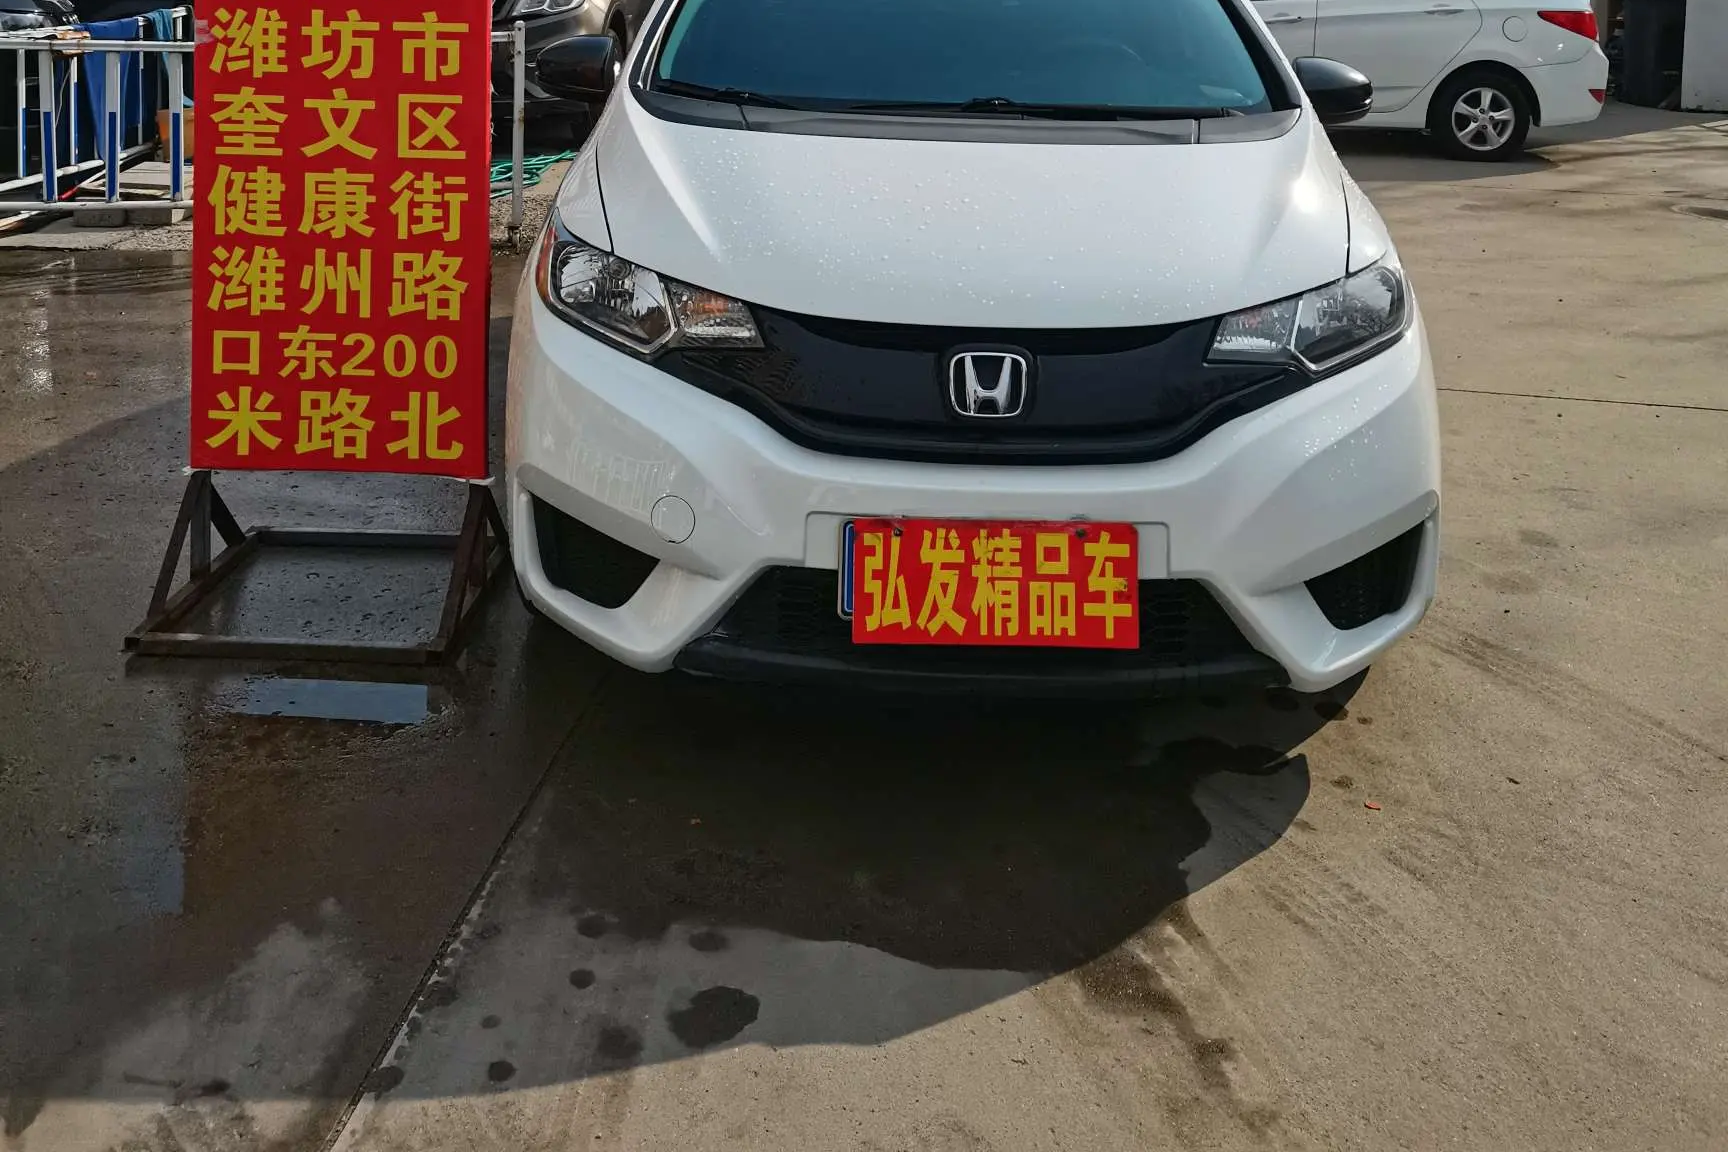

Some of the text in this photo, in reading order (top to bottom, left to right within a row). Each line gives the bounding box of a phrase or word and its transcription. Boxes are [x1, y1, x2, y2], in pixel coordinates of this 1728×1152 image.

[208, 7, 469, 82] 潍坊市
[209, 86, 467, 161] 奎文区
[207, 164, 469, 242] 健康街
[207, 245, 469, 321] 潍州路
[212, 325, 458, 380] 口东200
[205, 386, 464, 460] 米路北
[863, 527, 1133, 640] 弘发精品车
